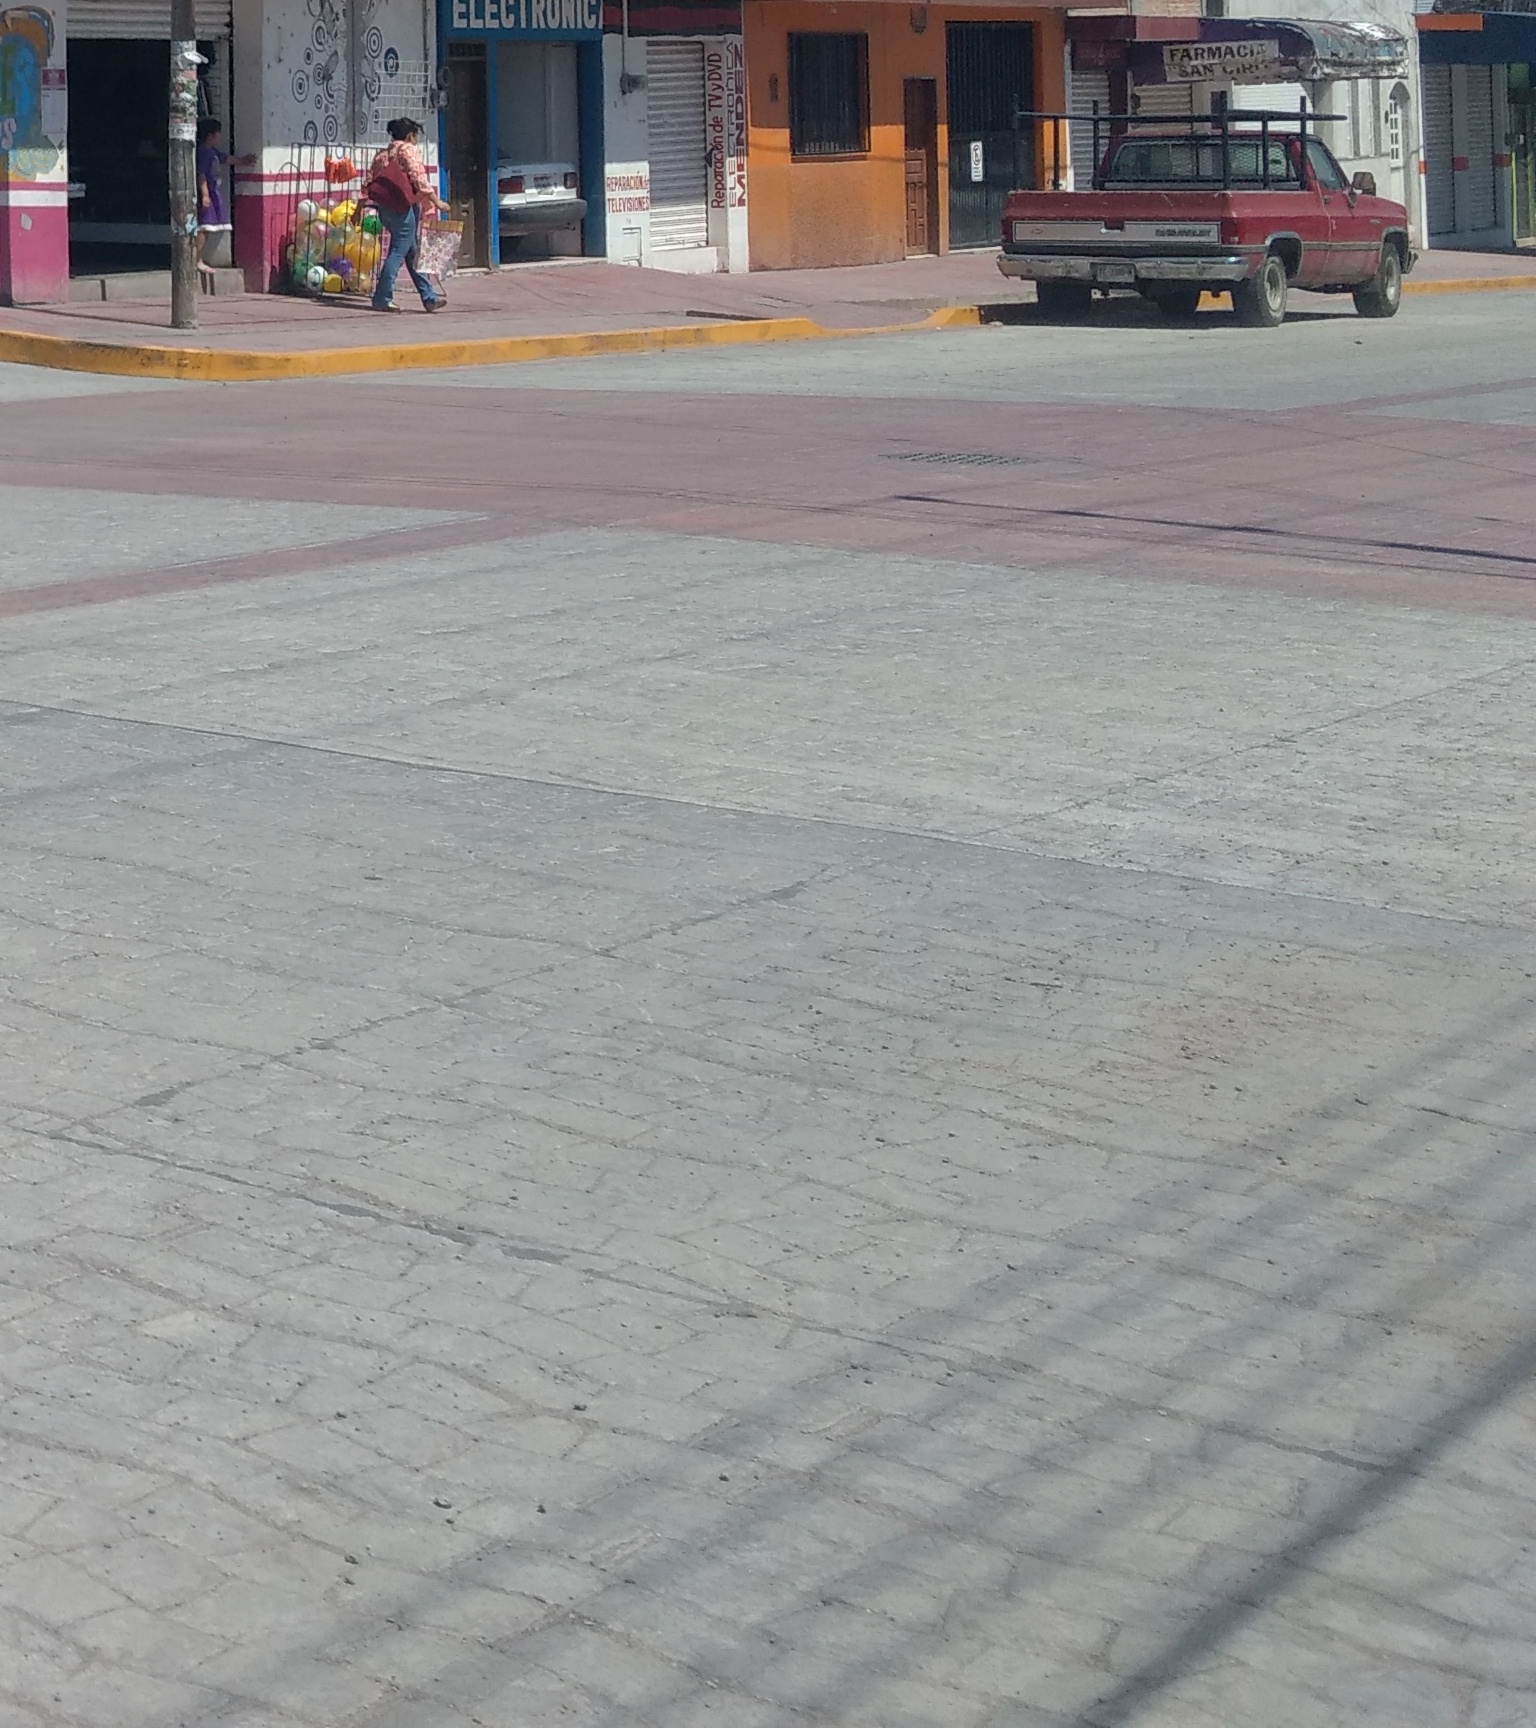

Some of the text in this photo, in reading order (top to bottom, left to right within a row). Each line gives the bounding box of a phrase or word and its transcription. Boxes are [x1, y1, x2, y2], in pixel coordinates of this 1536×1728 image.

[707, 53, 723, 82] DVD
[707, 93, 723, 111] TV
[708, 115, 724, 134] de
[734, 43, 746, 207] MENDEZ
